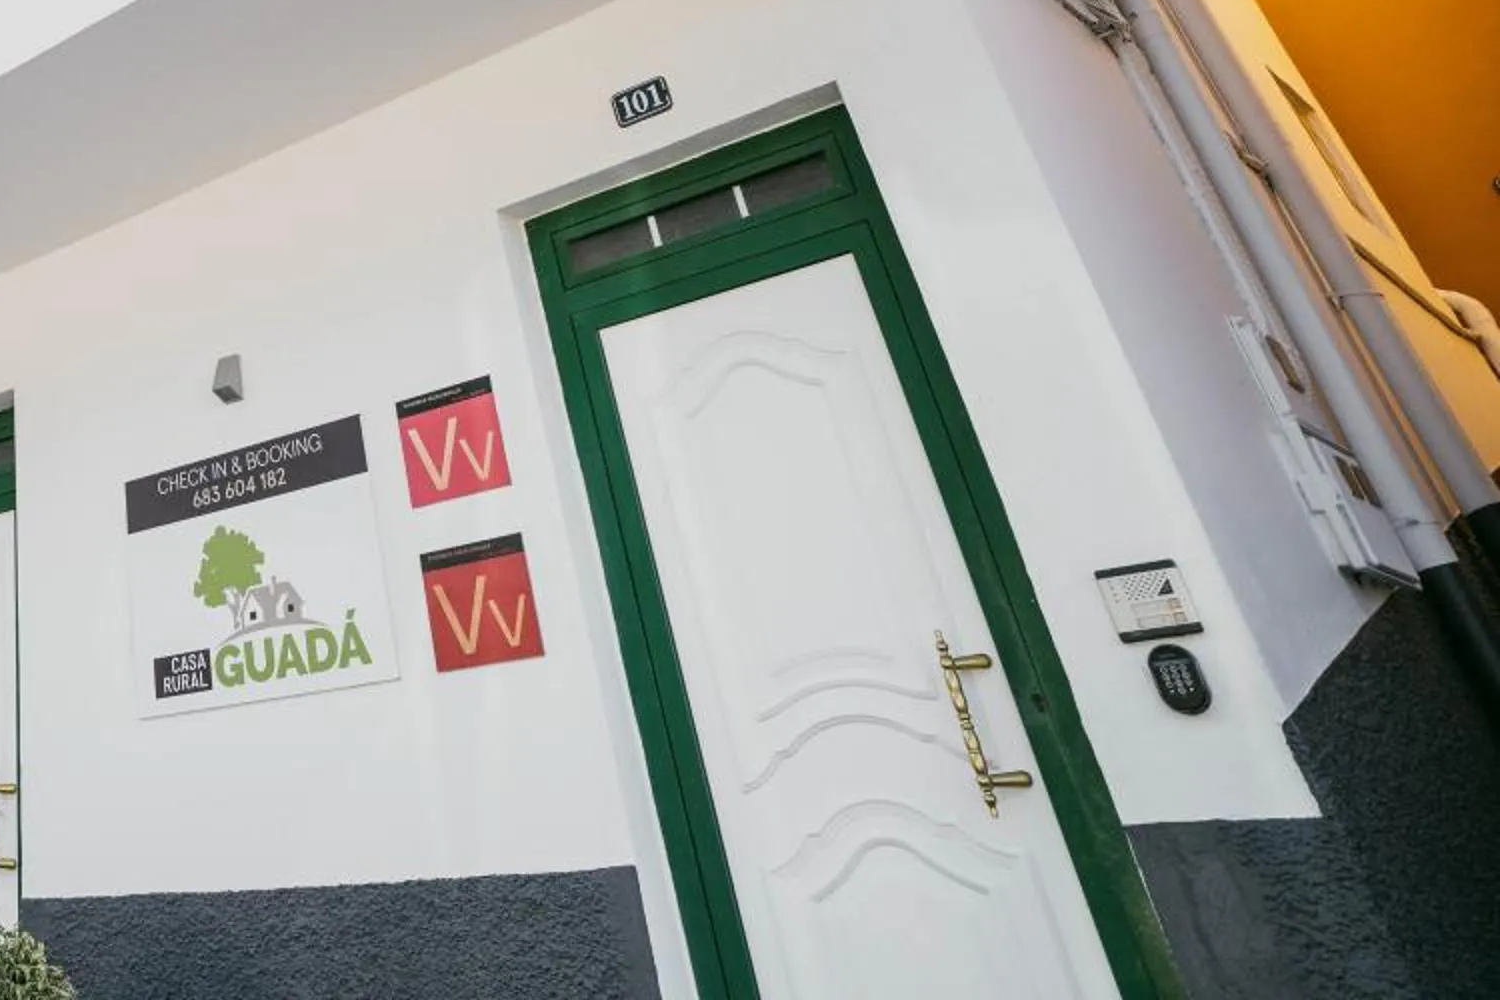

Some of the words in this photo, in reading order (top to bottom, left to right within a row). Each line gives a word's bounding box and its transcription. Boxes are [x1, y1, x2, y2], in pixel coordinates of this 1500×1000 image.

[619, 83, 664, 119] 101
[157, 466, 209, 495] CHECK
[211, 460, 227, 481] IN
[231, 455, 243, 475] &
[245, 433, 324, 471] BOOKING
[192, 484, 221, 508] 683
[225, 475, 257, 500] 604
[260, 466, 288, 491] 182
[171, 651, 207, 674] CASA
[215, 607, 373, 688] GUADÁ
[163, 670, 210, 693] RURAL
